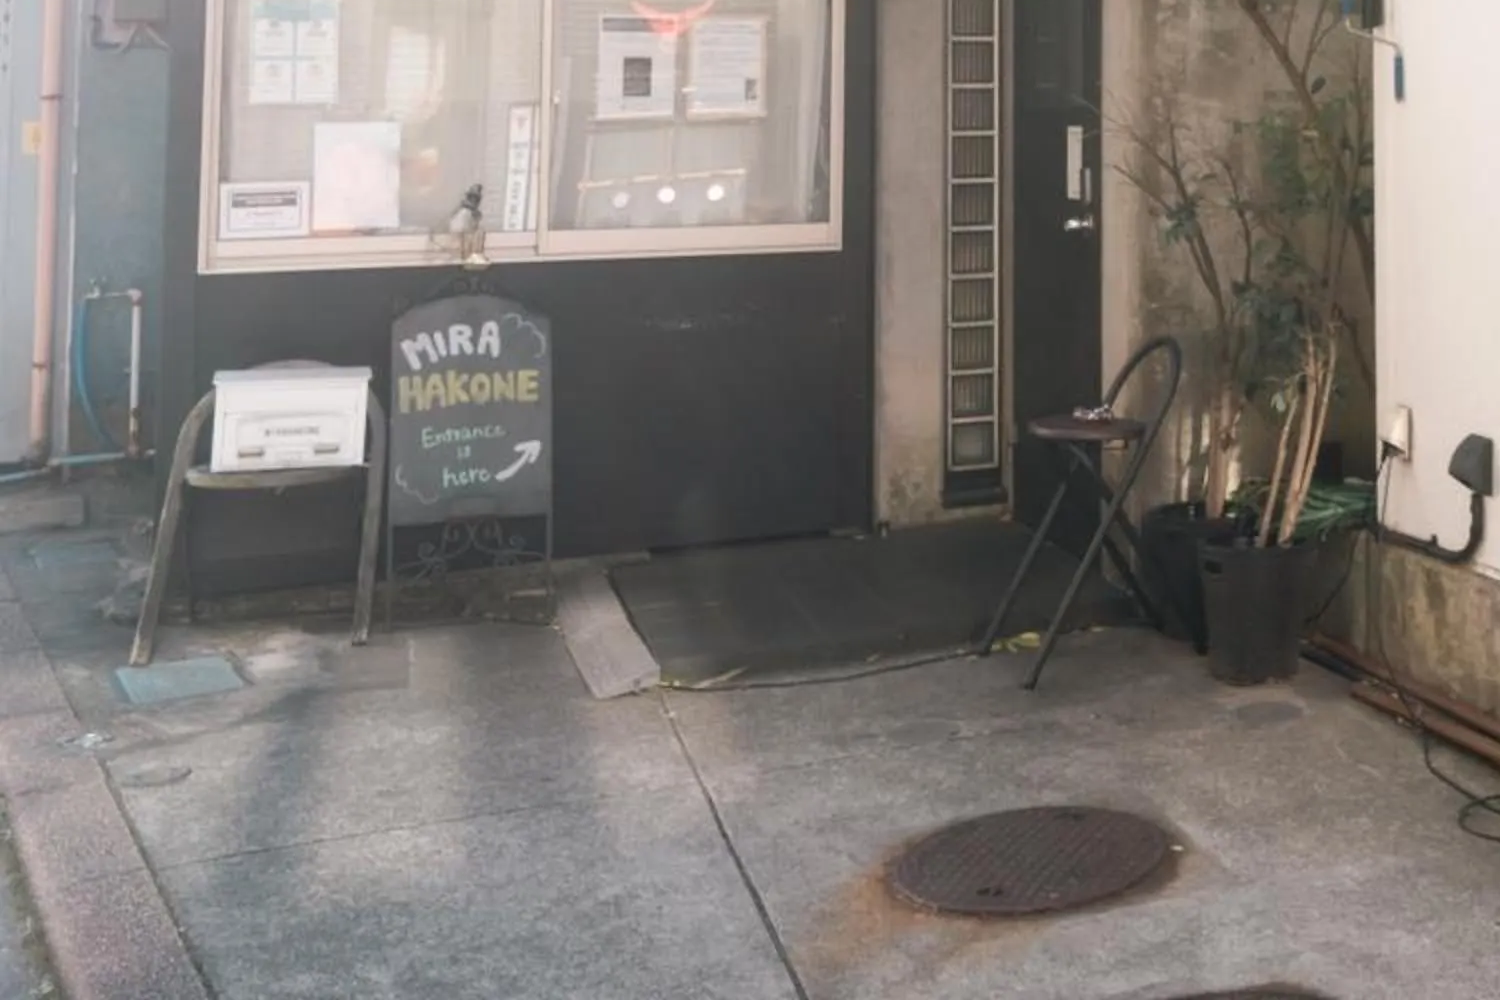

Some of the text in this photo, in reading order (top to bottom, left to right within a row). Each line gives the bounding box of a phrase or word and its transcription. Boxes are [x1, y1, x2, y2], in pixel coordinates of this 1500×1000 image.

[401, 320, 501, 371] MIRA
[398, 369, 541, 414] HAKONE
[421, 424, 507, 449] Entrance
[442, 467, 491, 488] here
